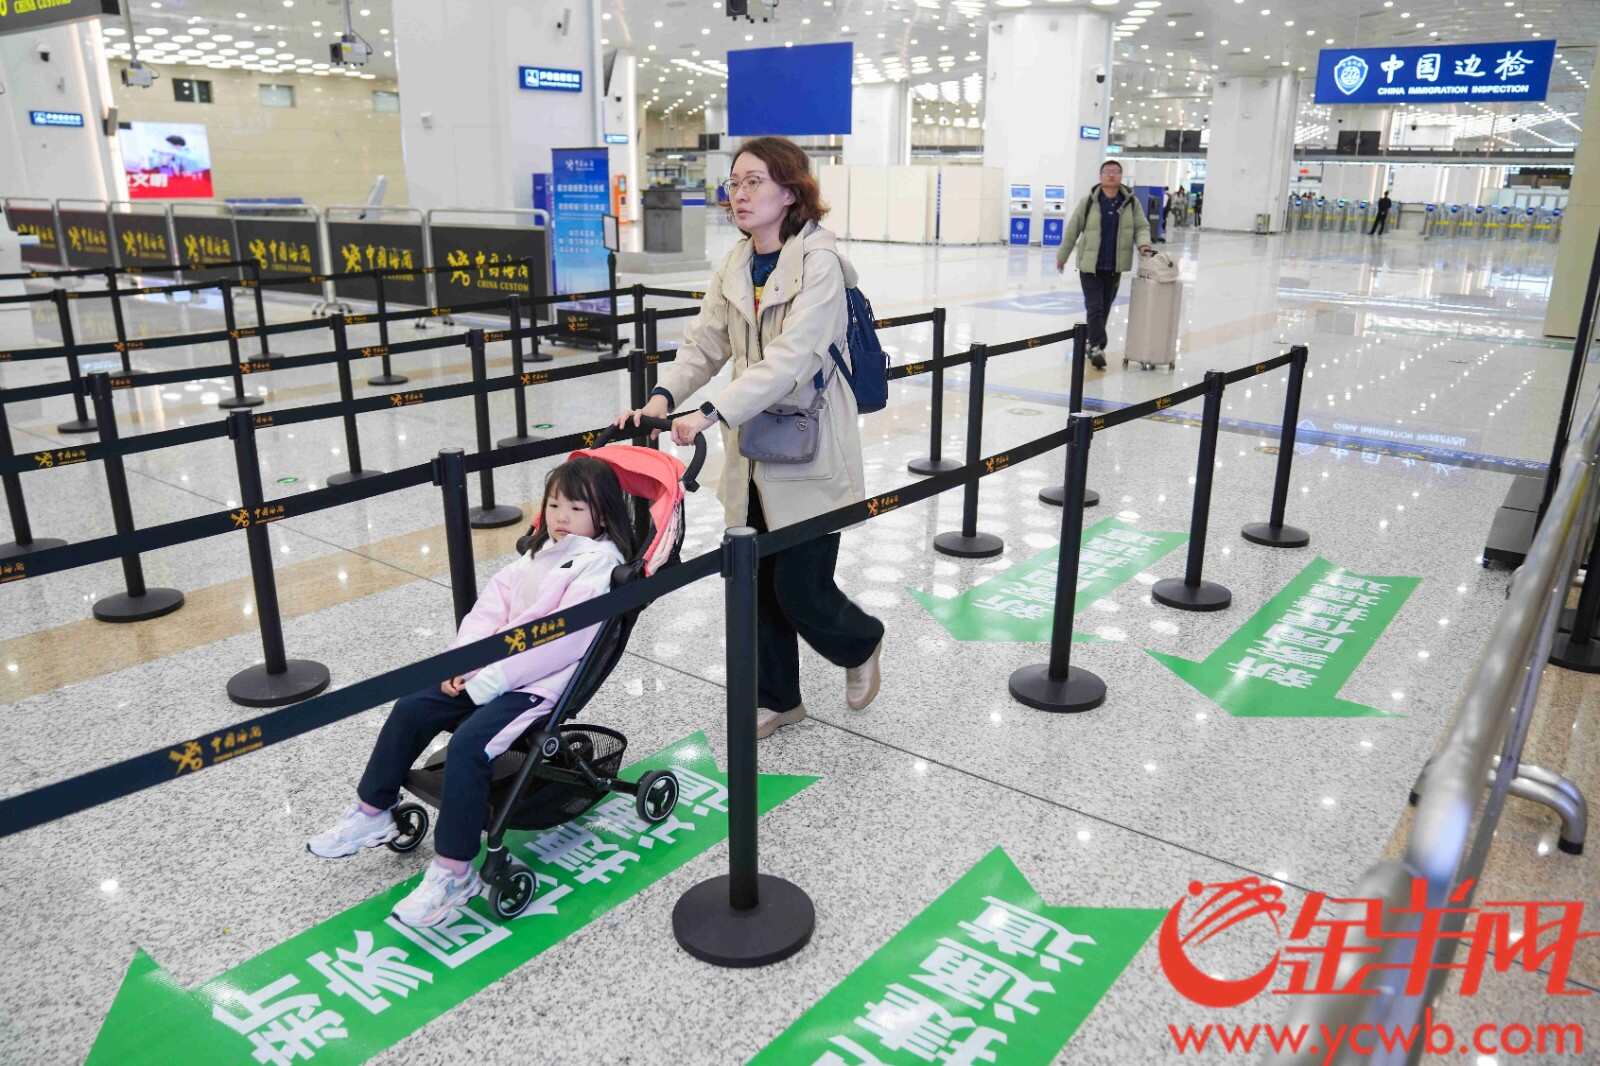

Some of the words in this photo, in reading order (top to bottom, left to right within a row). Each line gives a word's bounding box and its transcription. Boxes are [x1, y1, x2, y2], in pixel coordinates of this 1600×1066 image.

[1380, 50, 1534, 84] 中国边检
[1377, 87, 1405, 96] CHINA
[1408, 85, 1468, 95] IMMIGRATION
[1471, 84, 1530, 94] INSPECTION
